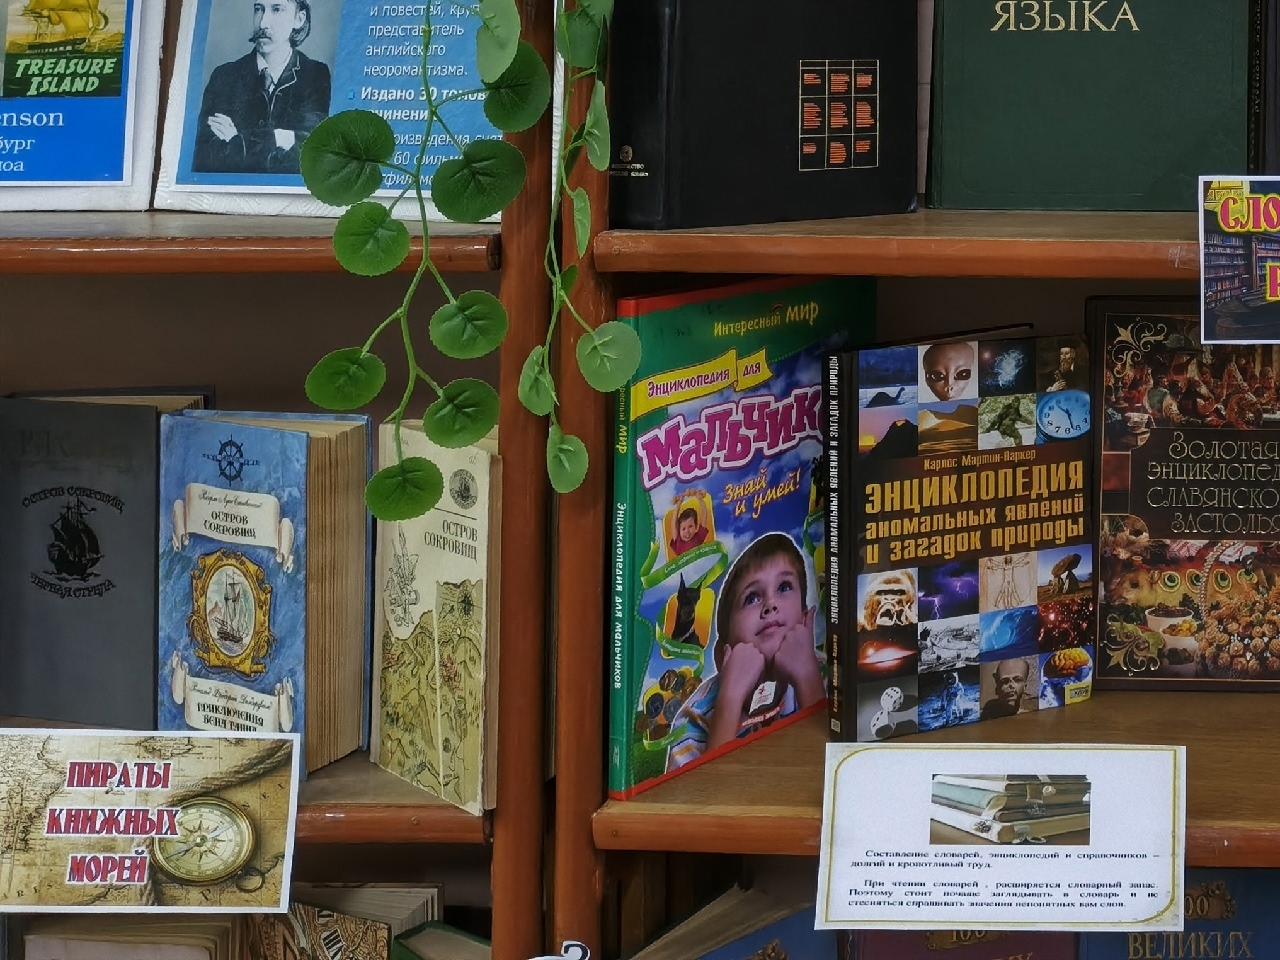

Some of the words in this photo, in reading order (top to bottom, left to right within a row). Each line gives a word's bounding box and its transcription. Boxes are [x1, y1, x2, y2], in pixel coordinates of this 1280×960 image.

[370, 7, 378, 17] и
[990, 0, 1140, 31] ЯЗЫКА
[15, 58, 117, 78] TREASURE
[27, 77, 99, 96] ISLAND
[361, 87, 415, 100] Издано
[714, 312, 781, 337] Интересный
[648, 368, 730, 397] Энциклопедия
[743, 361, 761, 377] для
[829, 356, 838, 395] ПРИРОДЫ
[829, 398, 838, 437] ЗАГАДОК
[829, 451, 838, 489] ЯВЛЕНИЙ
[924, 456, 958, 471] Карлос
[962, 449, 1036, 467] Мартин-Паркер
[723, 468, 769, 504] Знай
[735, 501, 746, 517] и
[752, 468, 801, 520] умей!
[865, 460, 1084, 514] ЭНЦИКЛОПЕДИЯ
[203, 520, 257, 539] СОКРОВИЩ
[211, 510, 249, 526] ОСТРОВ
[829, 492, 838, 554] АНОМАЛЬНЫХ
[866, 506, 997, 540] аномальных
[1005, 493, 1084, 522] явлений
[442, 519, 478, 543] ОСТРОВ
[866, 544, 878, 565] и
[890, 530, 982, 560] загадок
[991, 517, 1084, 552] природы
[424, 531, 478, 564] СОКРОВИЩ
[614, 502, 627, 591] Энциклопедия
[830, 556, 839, 625] ЭНЦИКЛОПЕДИЯ
[614, 595, 623, 617] для
[612, 621, 624, 690] мальчиков
[66, 761, 173, 789] ПИРАТЫ
[45, 808, 180, 836] КНИЖНЫХ
[67, 849, 148, 883] МОРЕЙ
[851, 860, 885, 868] долгий
[898, 860, 964, 869] кропотливый
[865, 849, 929, 858] Составление
[989, 851, 1060, 860] энциклопедий
[1077, 853, 1148, 861] справочников
[849, 889, 894, 898] Поэтому
[991, 891, 1054, 899] заглядывать
[1079, 891, 1120, 899] словарь
[864, 880, 885, 888] При
[933, 881, 979, 889] словарей
[996, 881, 1061, 889] расширяется
[1068, 881, 1122, 889] словарный
[848, 899, 903, 907] стесняться
[905, 899, 965, 908] спрашивать
[1128, 931, 1254, 960] ВЕЛИКИХ
